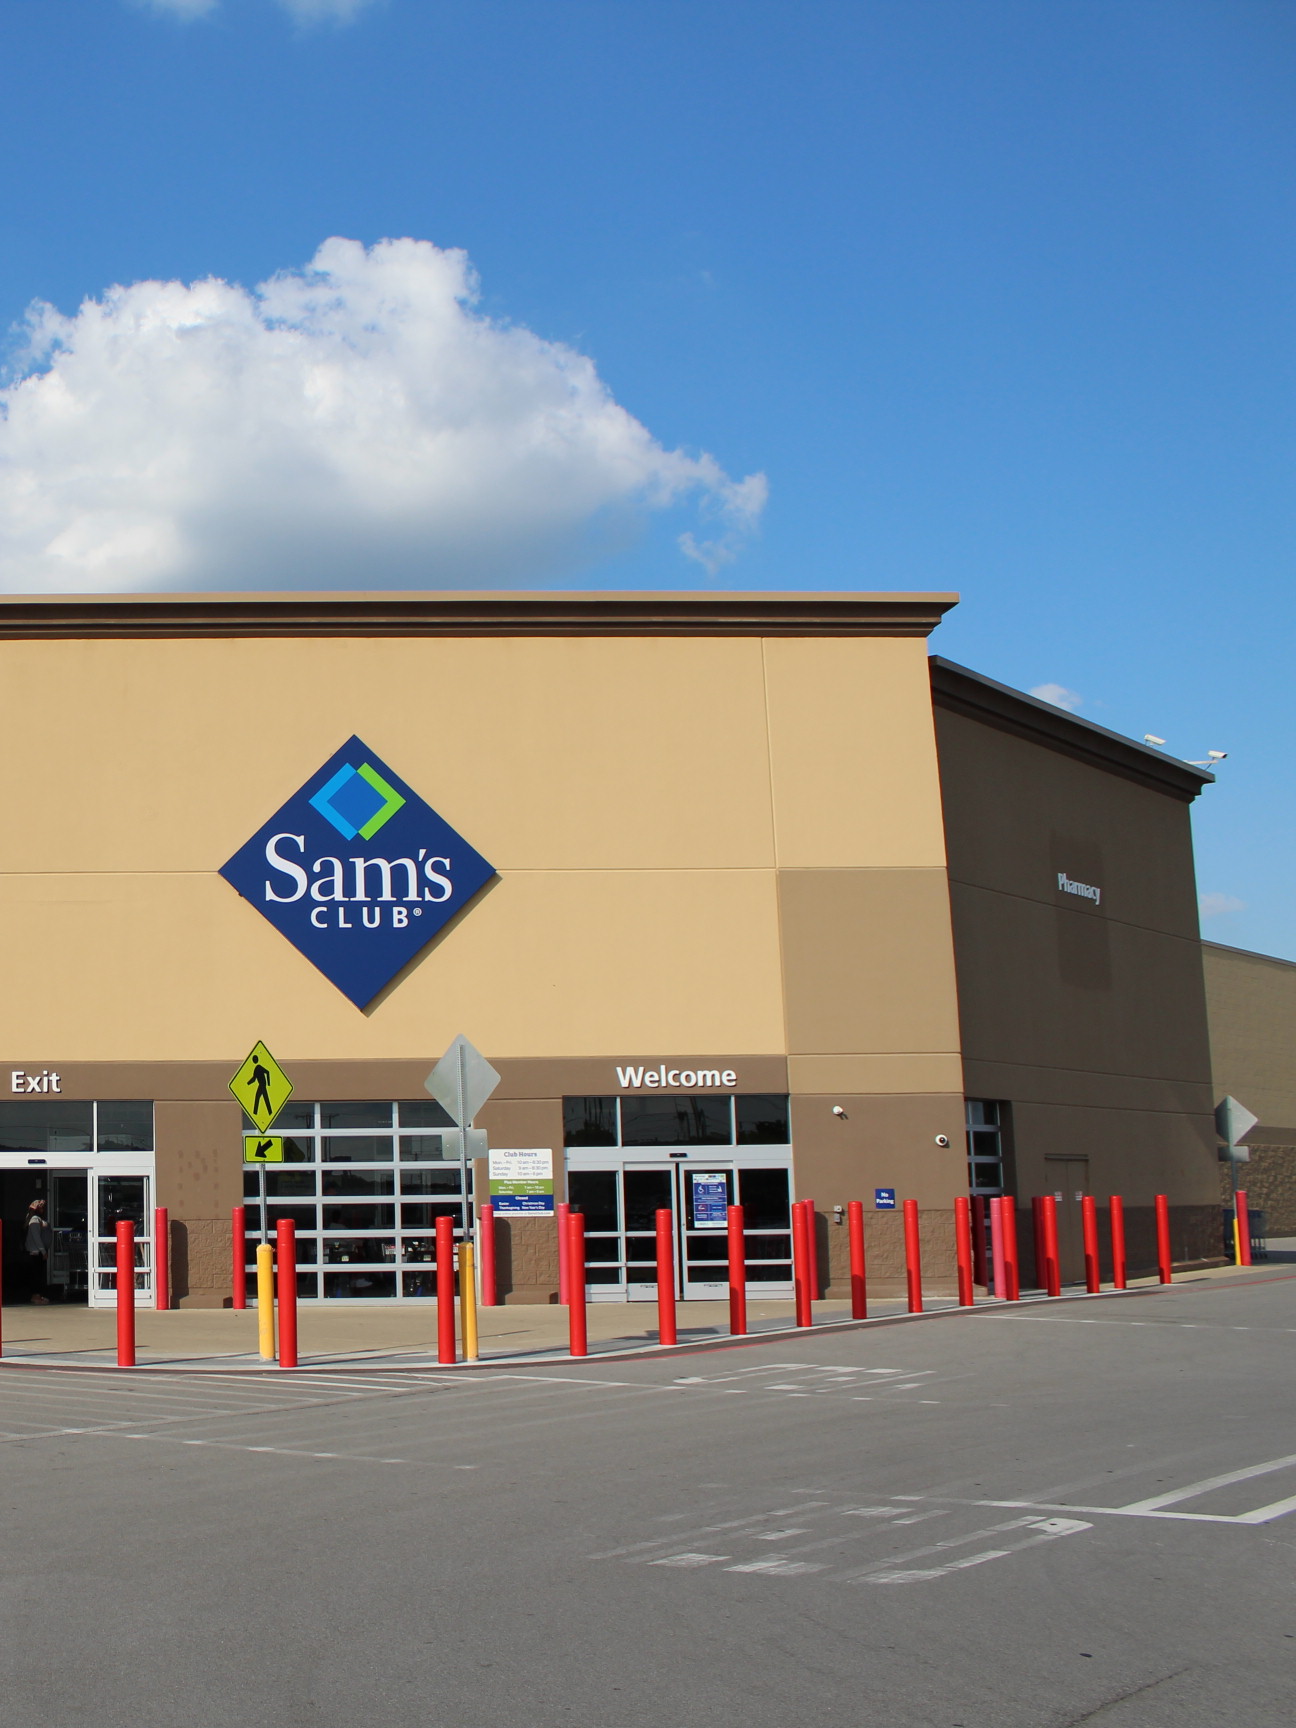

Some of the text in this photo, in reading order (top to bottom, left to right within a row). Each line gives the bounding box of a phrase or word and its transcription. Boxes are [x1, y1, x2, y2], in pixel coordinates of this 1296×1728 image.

[265, 833, 452, 903] Sam's
[1058, 873, 1100, 905] Pharmacy
[12, 1070, 61, 1092] Exit
[616, 1065, 737, 1088] Welcome
